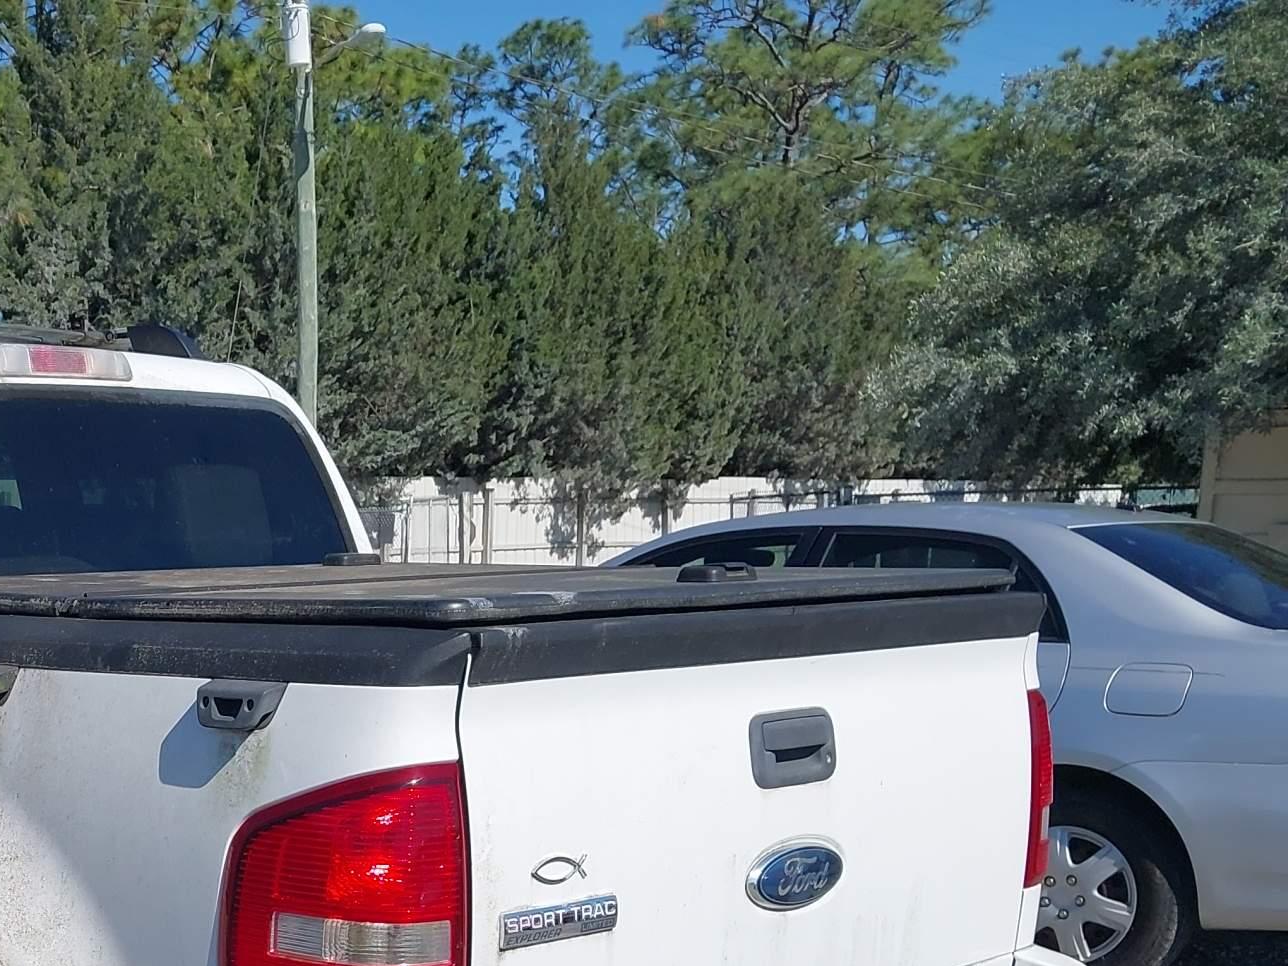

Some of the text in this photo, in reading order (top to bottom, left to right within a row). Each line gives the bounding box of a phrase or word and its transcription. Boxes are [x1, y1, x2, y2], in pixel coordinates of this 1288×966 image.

[777, 855, 830, 897] Ford
[505, 900, 616, 933] SPORT TRAC
[506, 928, 562, 946] EXPLORER
